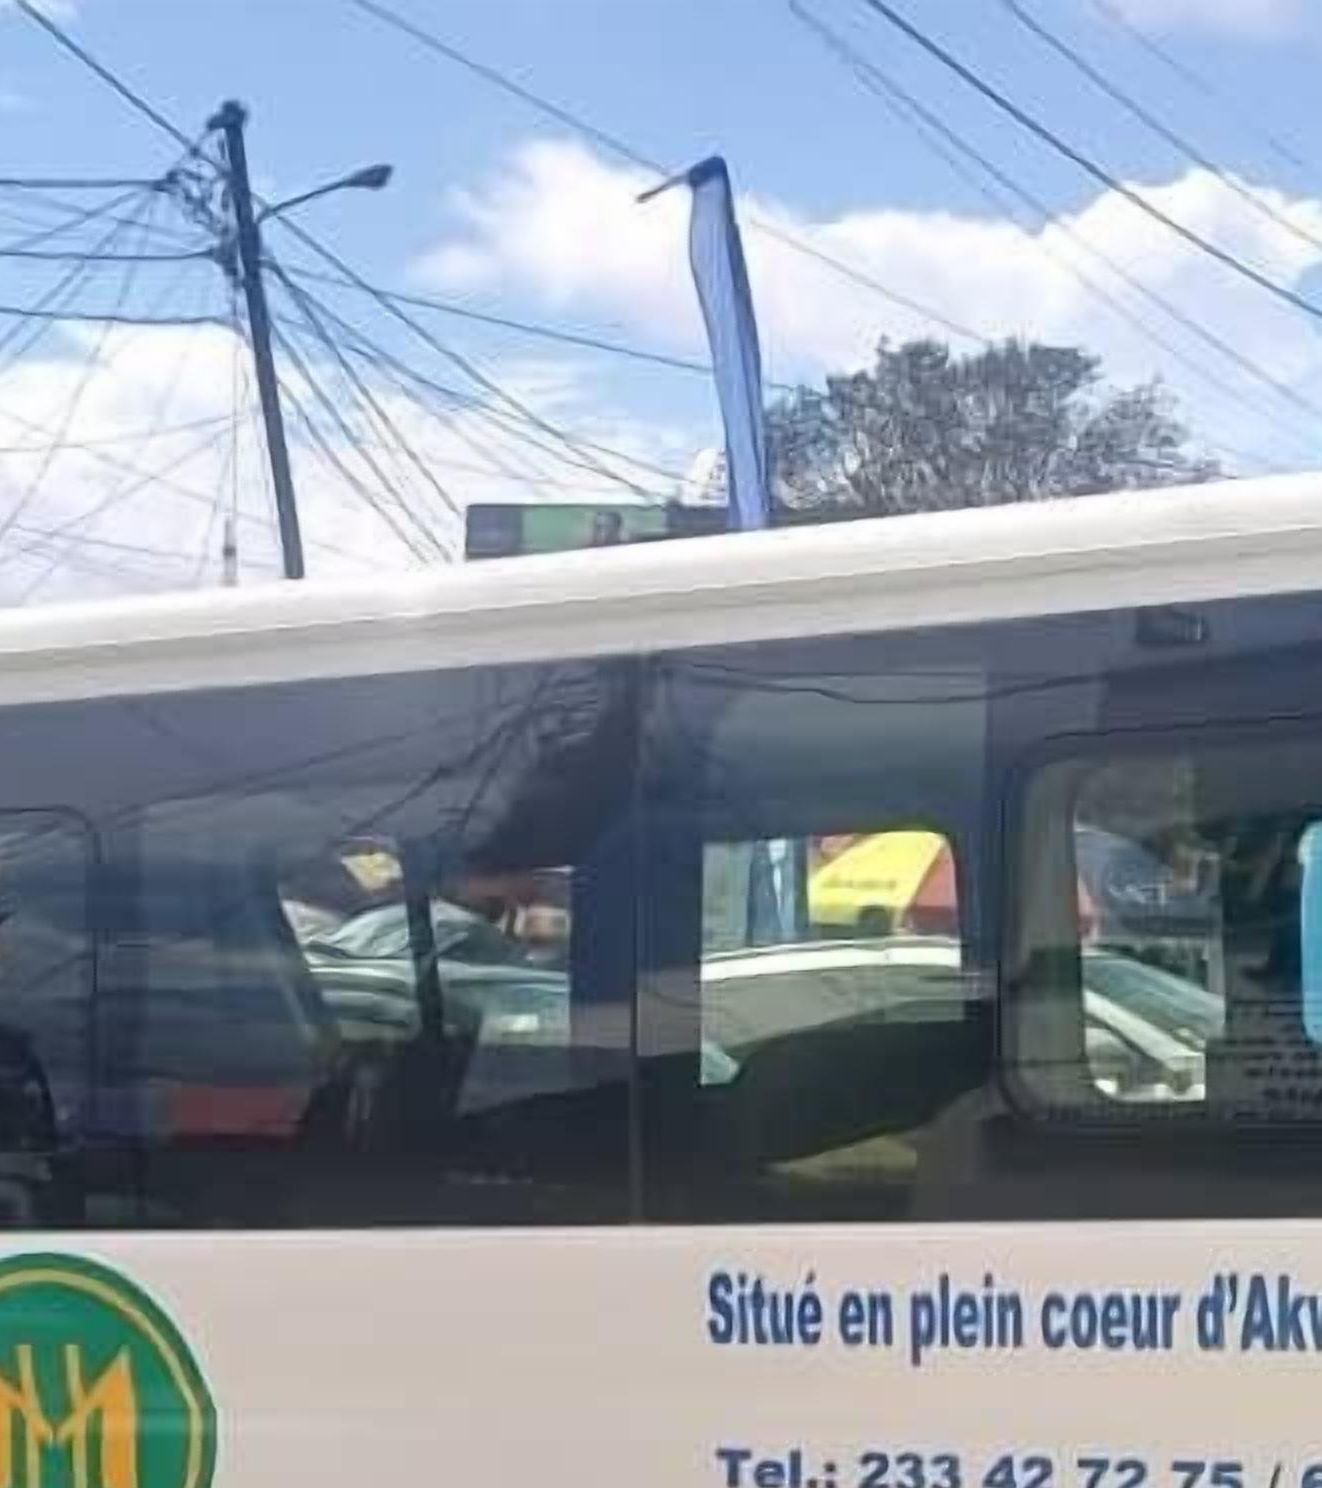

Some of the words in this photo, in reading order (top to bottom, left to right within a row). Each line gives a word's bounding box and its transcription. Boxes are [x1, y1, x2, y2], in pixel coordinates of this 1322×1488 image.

[708, 1271, 823, 1347] Situé
[839, 1291, 894, 1347] en
[911, 1272, 1024, 1367] plein
[1041, 1293, 1182, 1350] coeur
